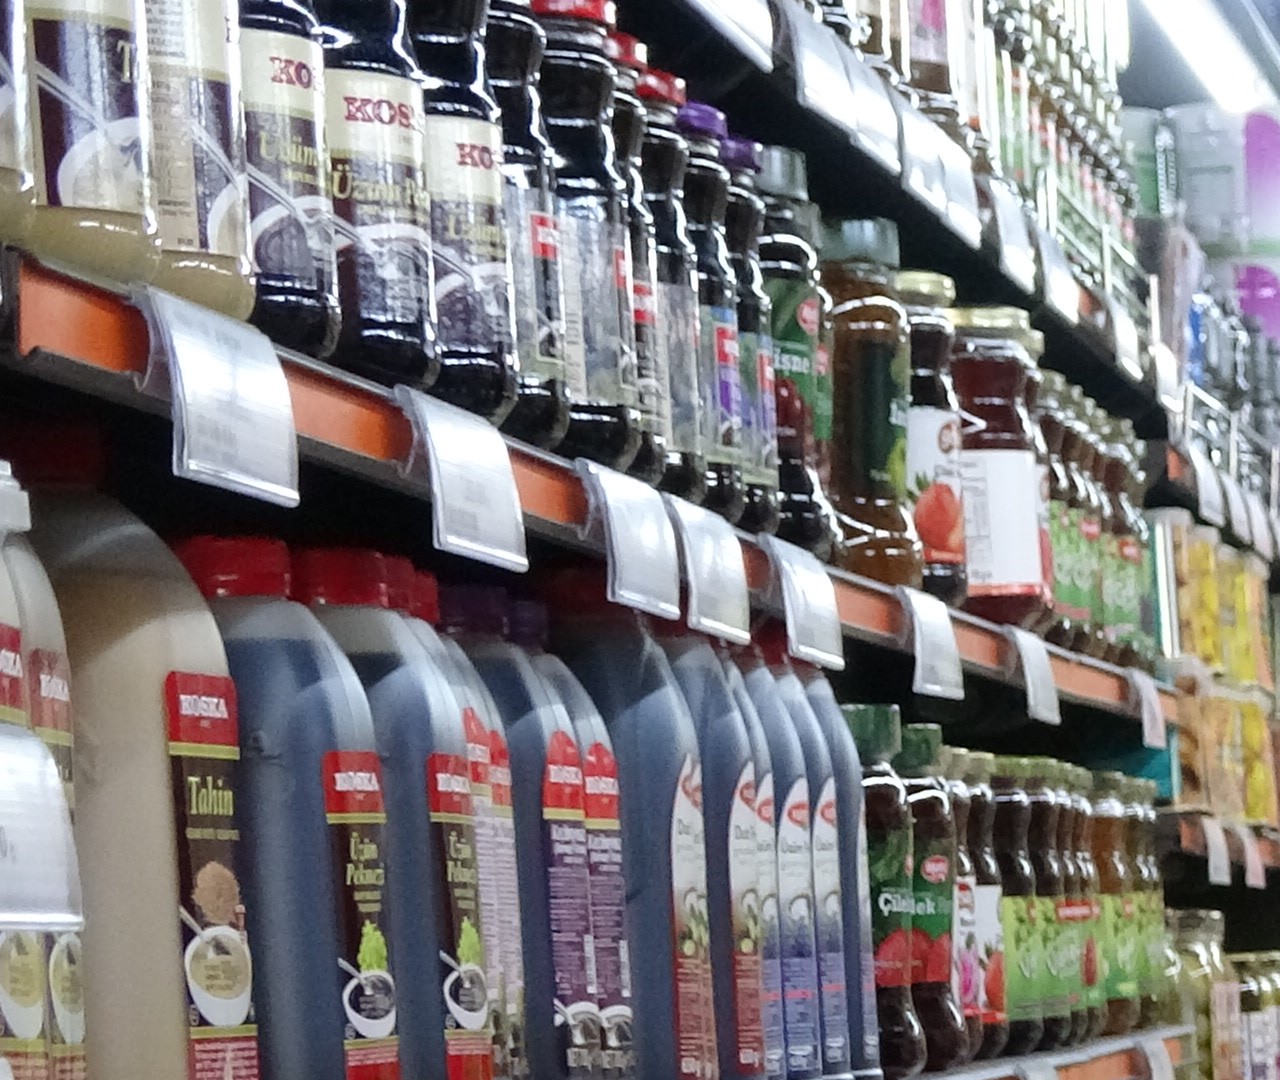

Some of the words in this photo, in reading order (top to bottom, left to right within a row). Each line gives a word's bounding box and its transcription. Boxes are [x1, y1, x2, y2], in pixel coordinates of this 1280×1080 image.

[269, 57, 313, 89] KO
[343, 96, 416, 129] KOS
[456, 143, 496, 171] KO
[179, 694, 229, 720] KOSKA
[186, 774, 234, 816] Tahin
